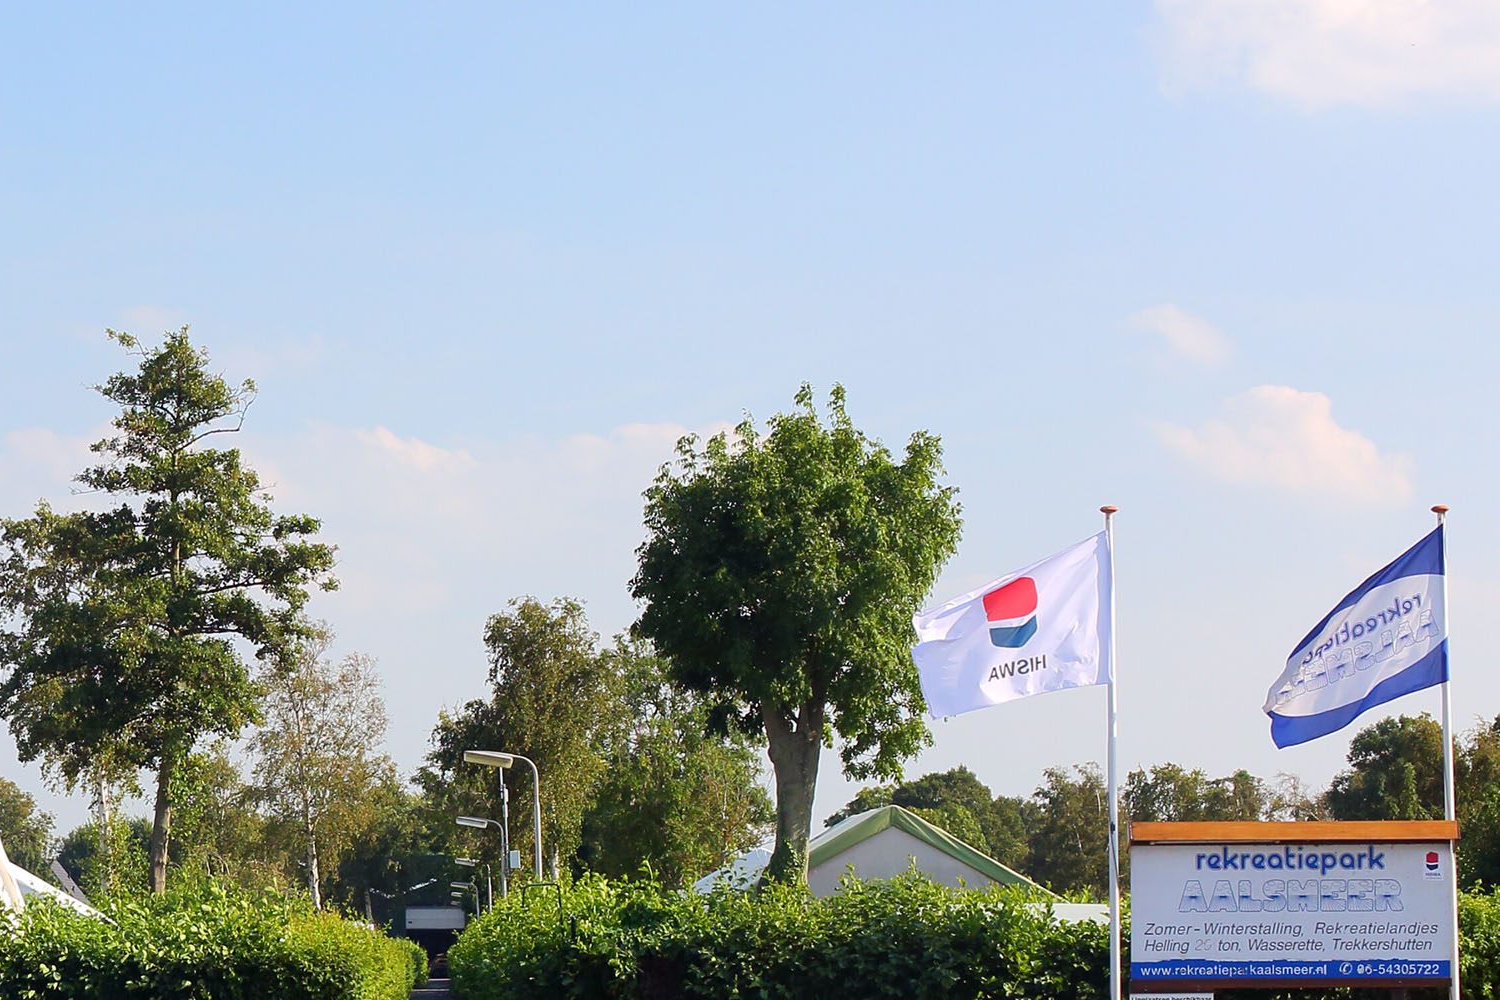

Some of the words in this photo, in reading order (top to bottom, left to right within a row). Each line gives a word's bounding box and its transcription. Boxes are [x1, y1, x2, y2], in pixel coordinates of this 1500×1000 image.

[1196, 845, 1385, 876] rekreatiepark
[1178, 878, 1405, 913] AALSMEER
[1314, 921, 1439, 937] Rekreatielandjes
[1144, 938, 1190, 955] Helling
[1218, 939, 1242, 953] ton,
[1248, 938, 1326, 953] Wasserette,
[1332, 937, 1433, 951] Trekkershutten
[1356, 963, 1440, 975] 06-54305722
